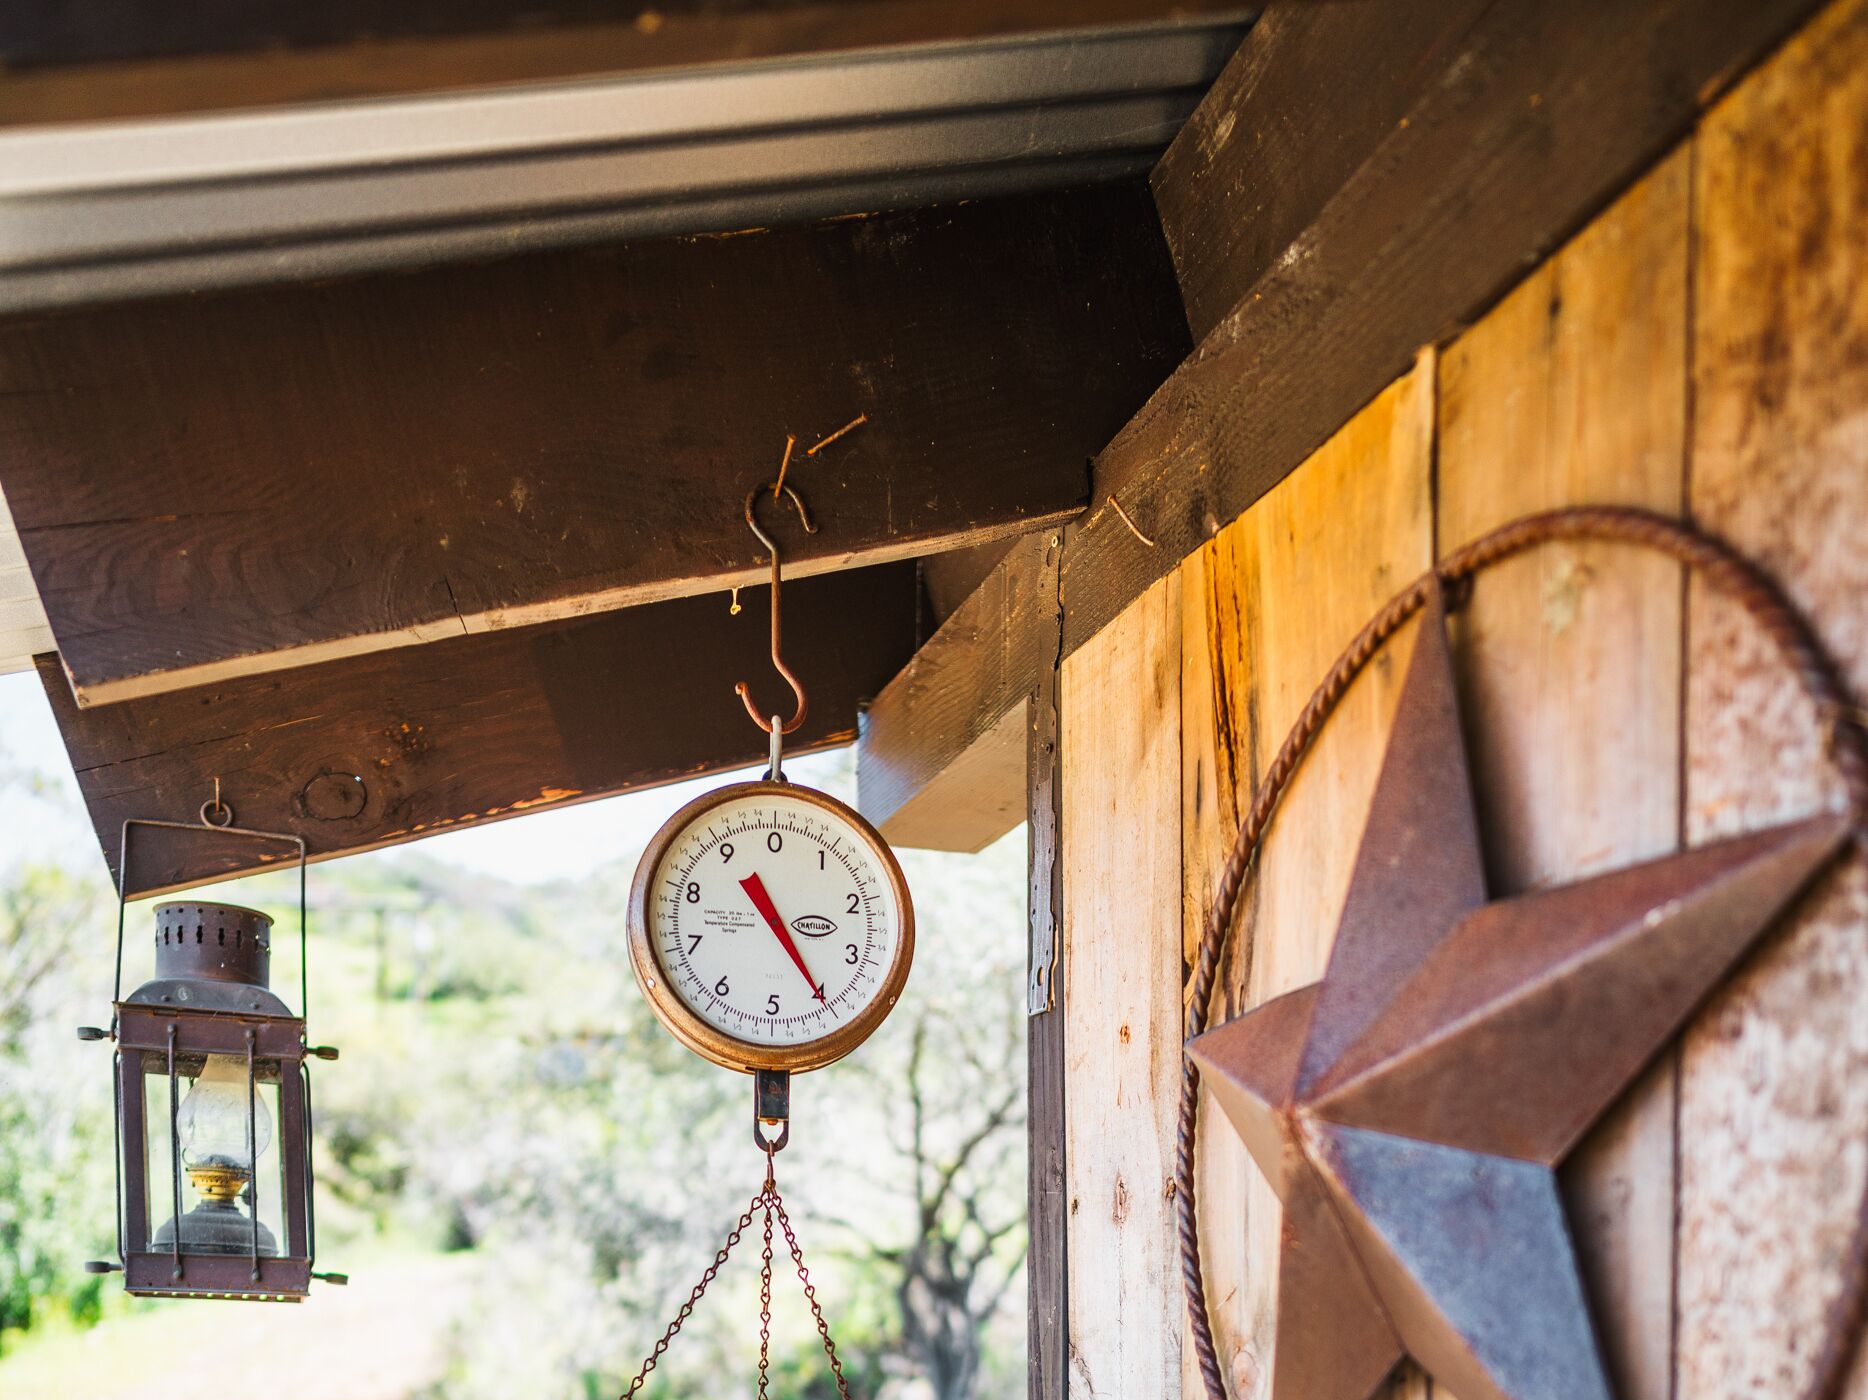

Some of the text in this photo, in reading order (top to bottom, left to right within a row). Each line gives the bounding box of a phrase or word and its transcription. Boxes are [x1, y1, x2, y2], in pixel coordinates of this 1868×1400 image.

[767, 832, 783, 853] 0
[720, 843, 735, 864] 9
[817, 850, 825, 870] 1
[686, 882, 701, 904] 8
[846, 893, 860, 914] 2
[797, 922, 830, 930] CHATILLON
[687, 934, 703, 956] 7
[845, 944, 858, 965] 3
[714, 975, 730, 997] 6
[811, 982, 827, 1001] 4
[765, 994, 780, 1015] 5
